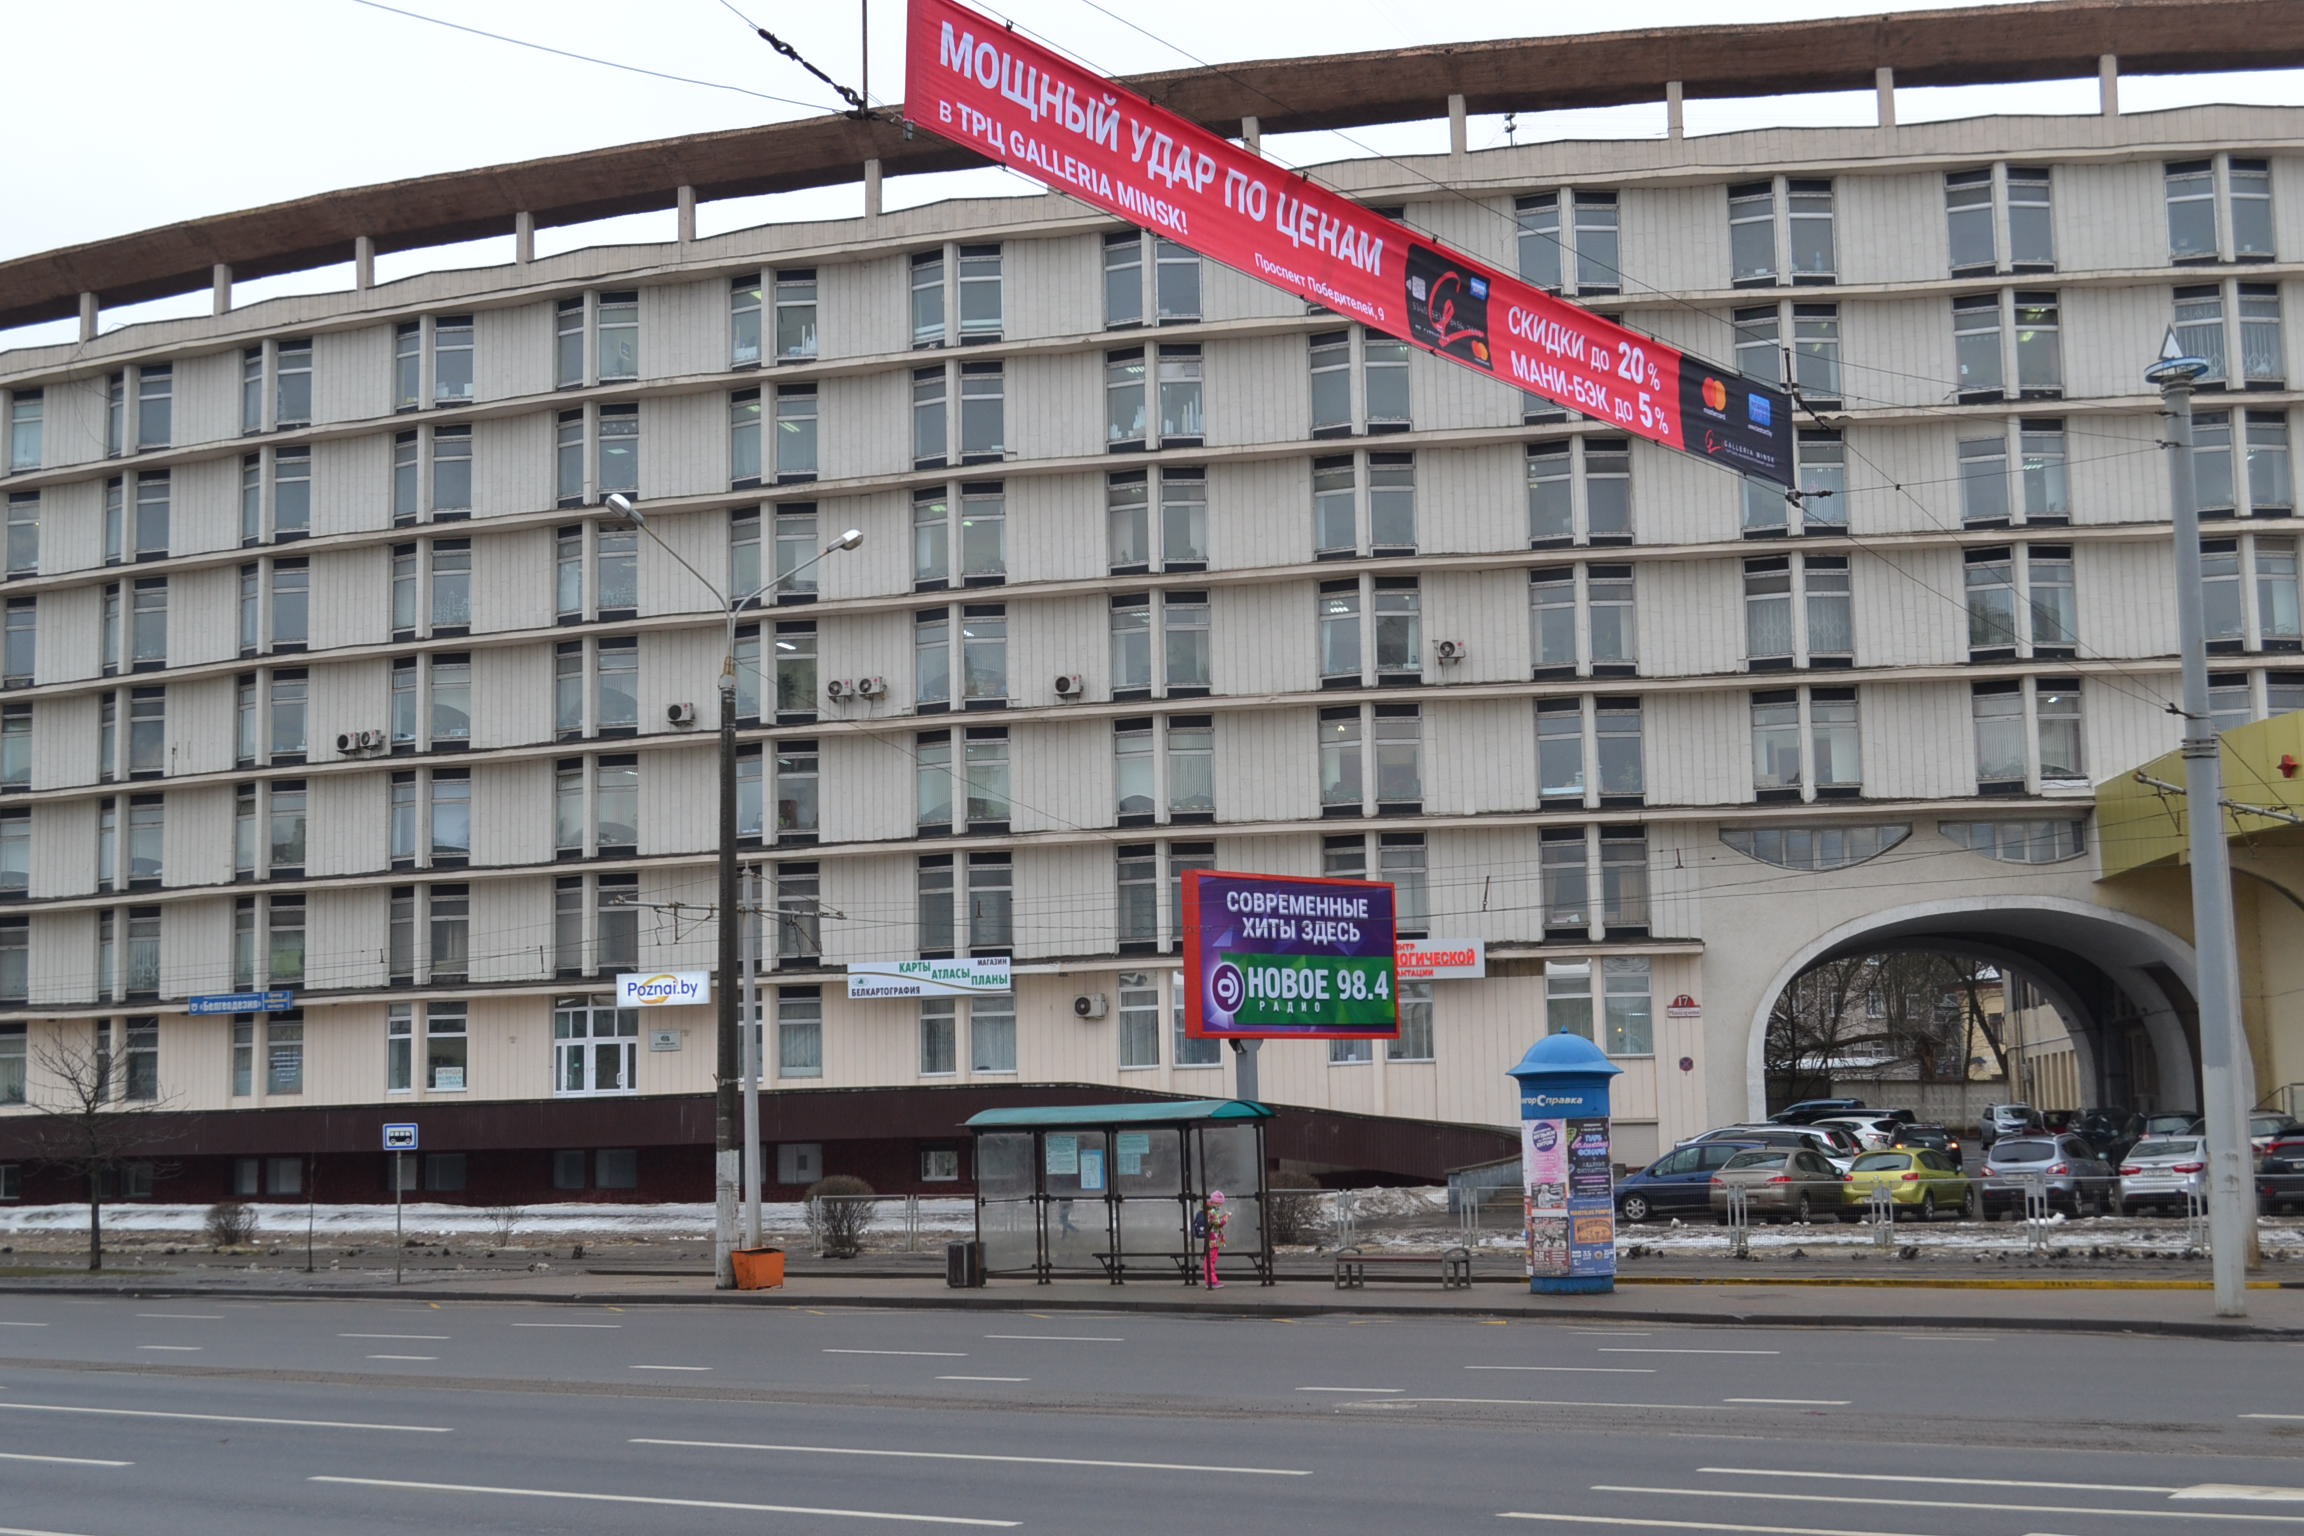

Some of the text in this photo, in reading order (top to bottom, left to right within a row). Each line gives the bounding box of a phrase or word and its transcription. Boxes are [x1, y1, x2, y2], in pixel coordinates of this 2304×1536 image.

[940, 20, 1383, 277] МОЩНЫЙ УДАР ПО ЦЕНАМ
[956, 102, 1006, 156] ТРЦ
[1010, 130, 1113, 201] GALLERIA
[1117, 180, 1188, 236] MINSK!
[1255, 252, 1306, 287] Проспект
[1307, 276, 1377, 320] Победителей,
[1378, 307, 1385, 321] 9
[1508, 306, 1585, 361] СКИДКИ
[1591, 347, 1609, 372] до
[1511, 350, 1610, 413] МАНИ-БЭК
[1615, 398, 1632, 423] до
[1226, 891, 1369, 919] СОВРЕМЕННЫЕ
[1242, 917, 1361, 945] ХИТЫ ЗДЕСЬ
[977, 958, 1007, 966] МАГАЗИН
[1397, 947, 1475, 965] ОГИЧЕСКОЙ
[899, 962, 930, 973] КАРТЫ
[931, 968, 970, 980] АТЛАСЫ
[627, 979, 698, 998] Poznai.by
[971, 974, 1008, 985] ПЛАНЫ
[1248, 966, 1389, 1001] НОВОЕ 98.4
[851, 986, 920, 997] БЕЛКАРТОГРАФИЯ
[1678, 996, 1689, 1006] 17
[1260, 1001, 1321, 1014] РАДИО
